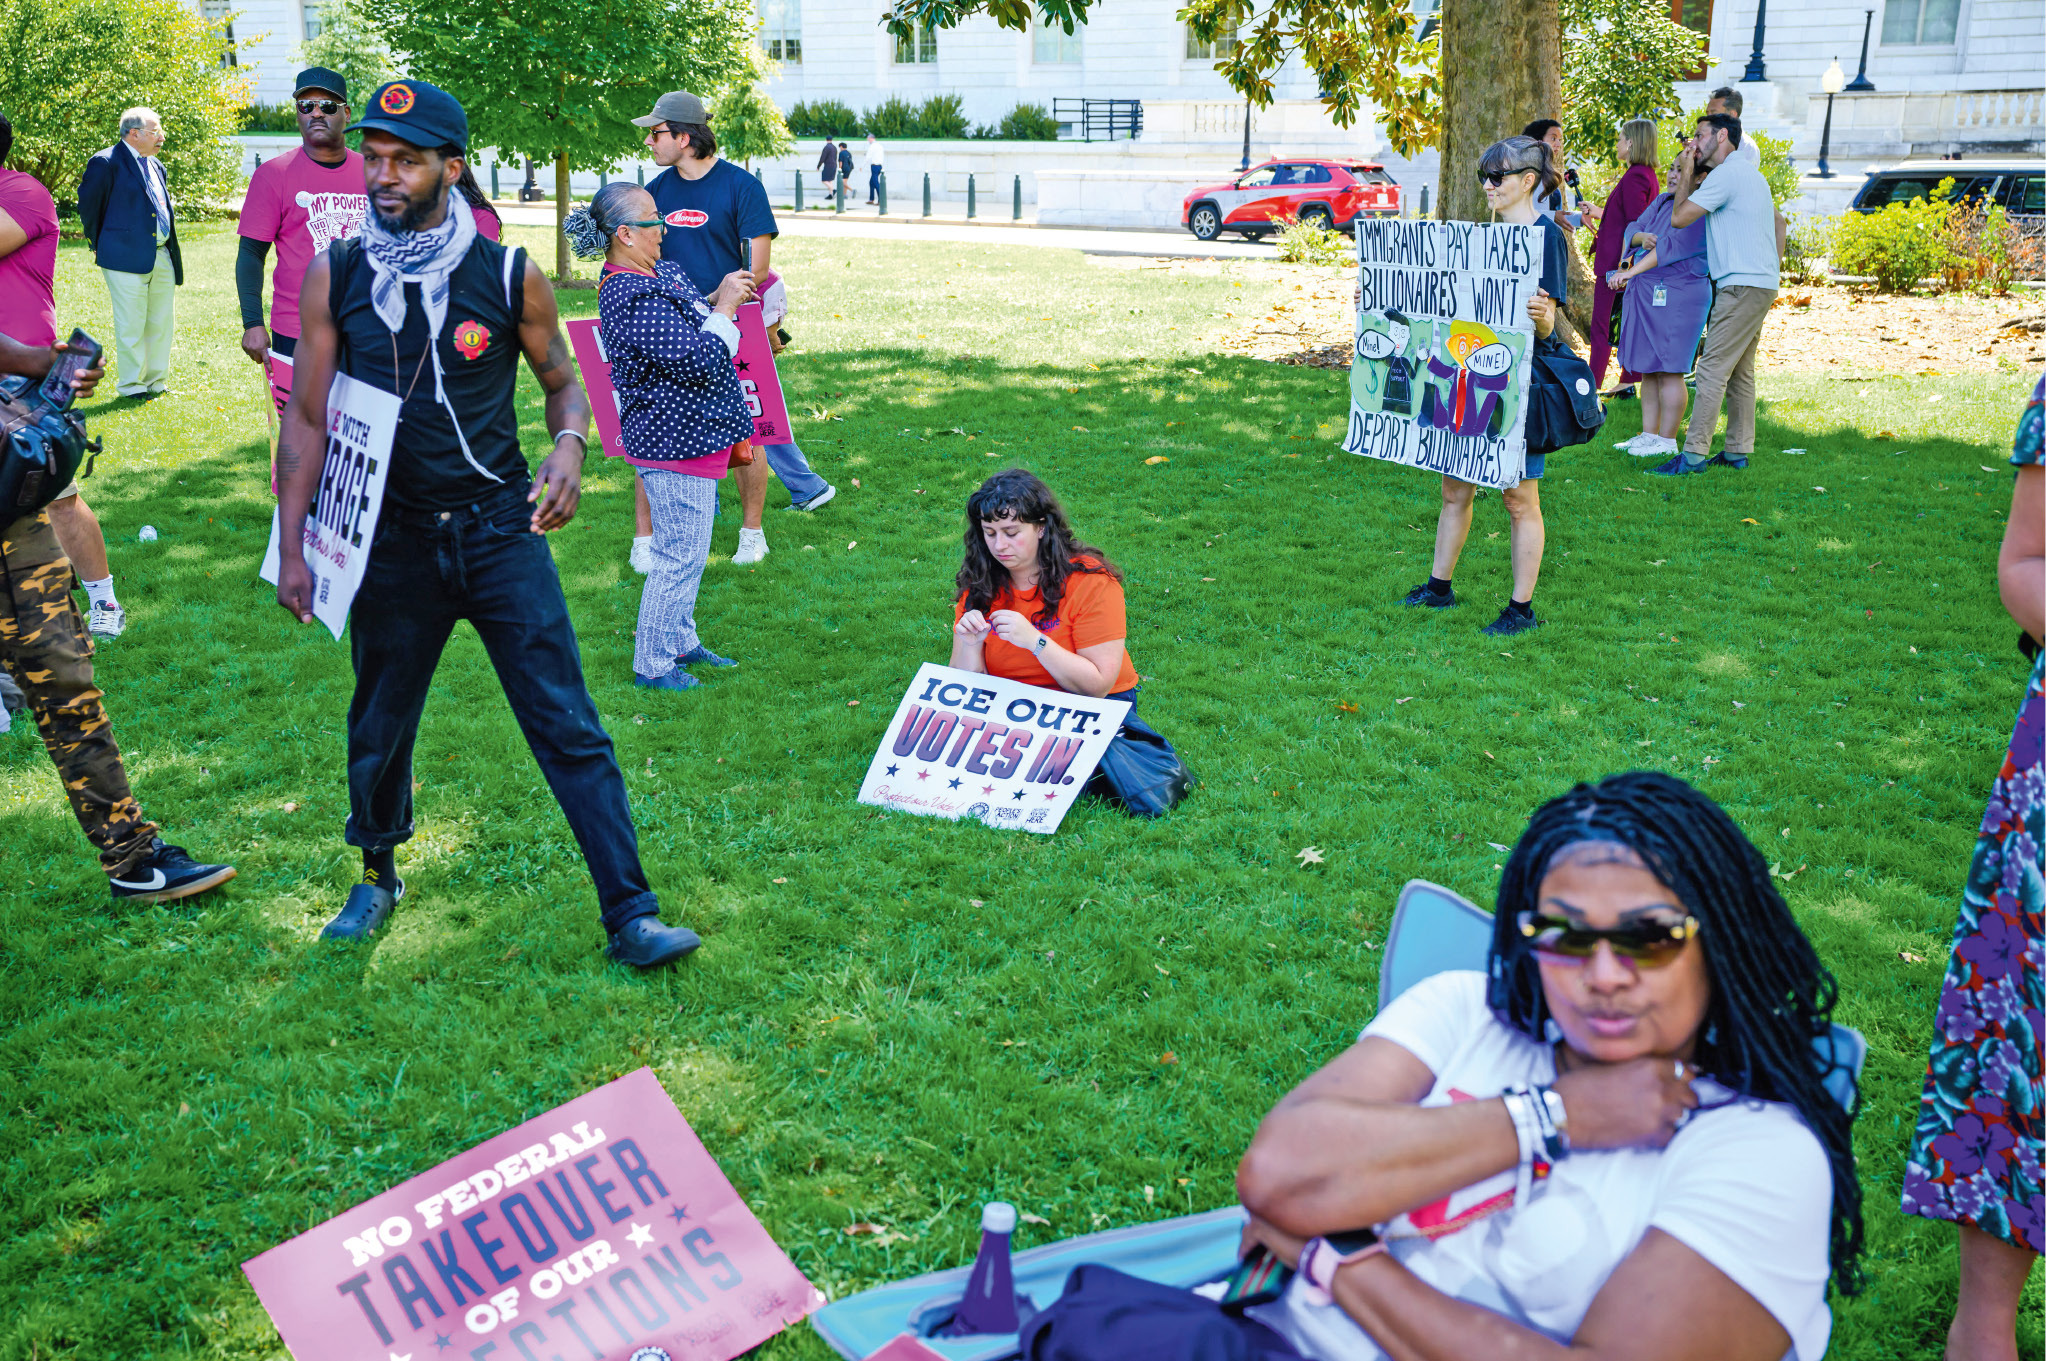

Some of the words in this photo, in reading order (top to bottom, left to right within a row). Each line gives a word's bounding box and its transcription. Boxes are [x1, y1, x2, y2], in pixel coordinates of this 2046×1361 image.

[311, 195, 329, 217] MY
[1358, 220, 1436, 268] IMMIGRANTS
[1446, 222, 1474, 271] PAY
[1481, 224, 1531, 275] TAXES
[1362, 267, 1458, 319] BILLIONAIRES
[1472, 276, 1520, 327] WON'T
[1362, 335, 1381, 354] Mine!
[1473, 350, 1505, 370] MINE!
[342, 412, 371, 448] WITH
[1349, 410, 1411, 462] DEPORT
[1415, 427, 1506, 485] BILLIONAIRES
[918, 677, 998, 715] ICE
[1006, 698, 1102, 736] OUT.
[892, 703, 1034, 780] VOTES
[1024, 734, 1085, 786] IN.
[342, 1215, 413, 1267] NO
[414, 1121, 607, 1230] FEDERAL
[336, 1138, 671, 1347] TAKEOVER
[464, 1286, 520, 1334] OF
[529, 1239, 620, 1299] OUR
